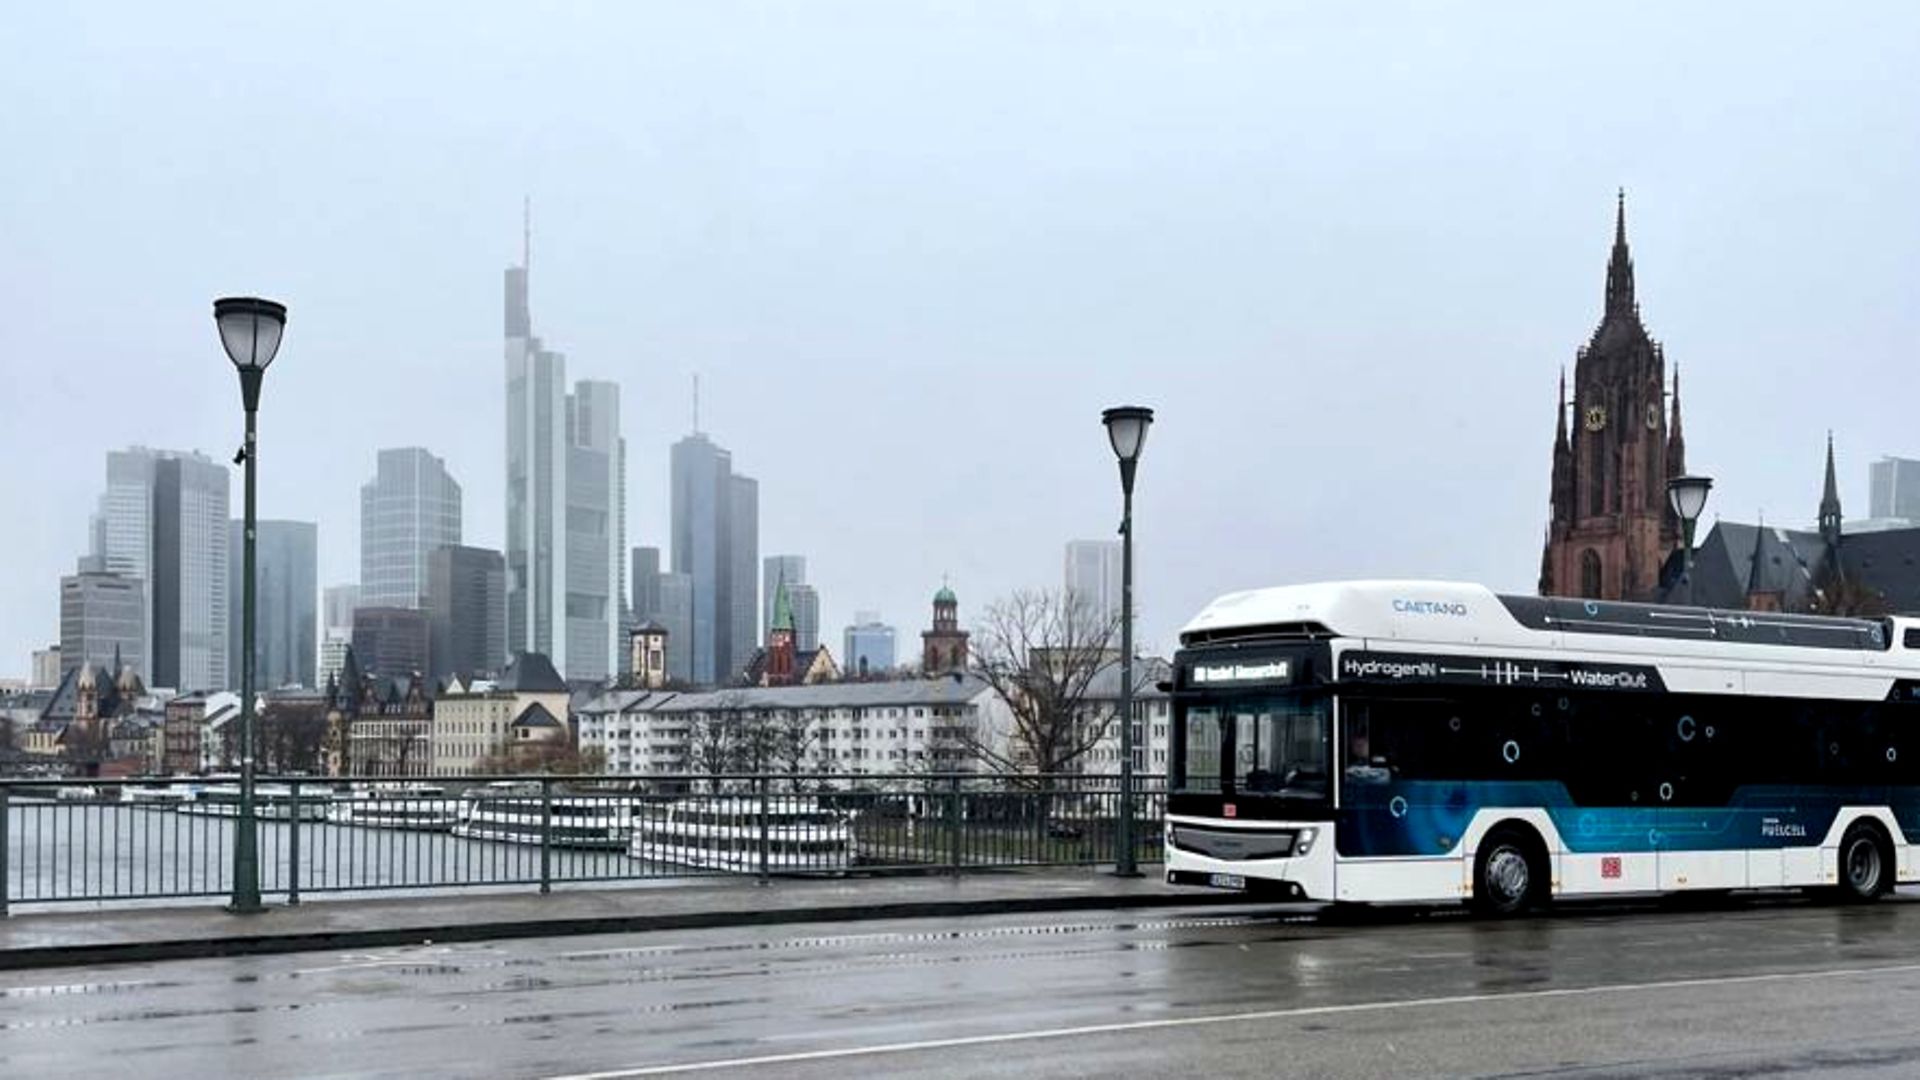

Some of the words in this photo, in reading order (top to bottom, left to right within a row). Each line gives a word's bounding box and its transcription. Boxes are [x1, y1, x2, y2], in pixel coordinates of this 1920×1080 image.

[1392, 599, 1467, 616] CAETANO
[1344, 660, 1437, 678] HydrogenIN
[1570, 670, 1647, 688] WaterOut
